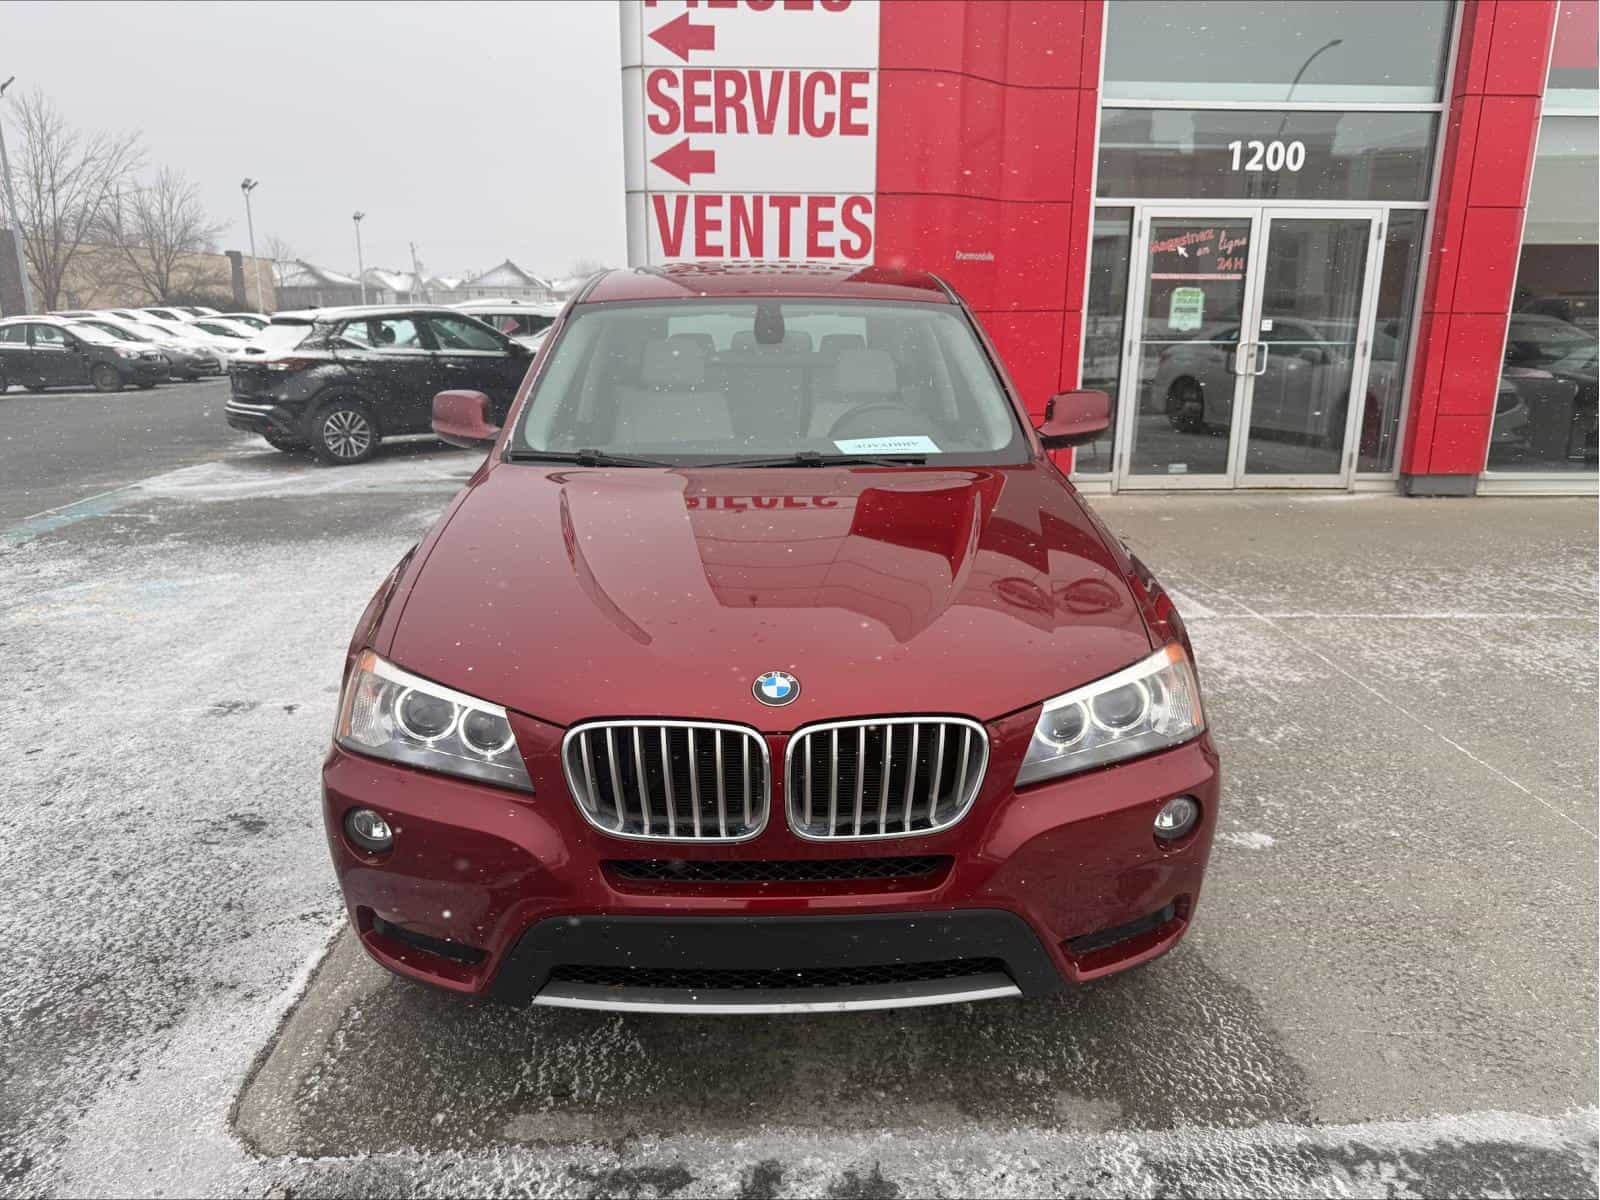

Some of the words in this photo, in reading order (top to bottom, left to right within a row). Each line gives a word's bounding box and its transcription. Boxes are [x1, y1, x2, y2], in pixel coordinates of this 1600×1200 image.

[646, 69, 870, 138] SERVICE
[1228, 140, 1306, 171] 1200
[652, 194, 874, 260] VENTES
